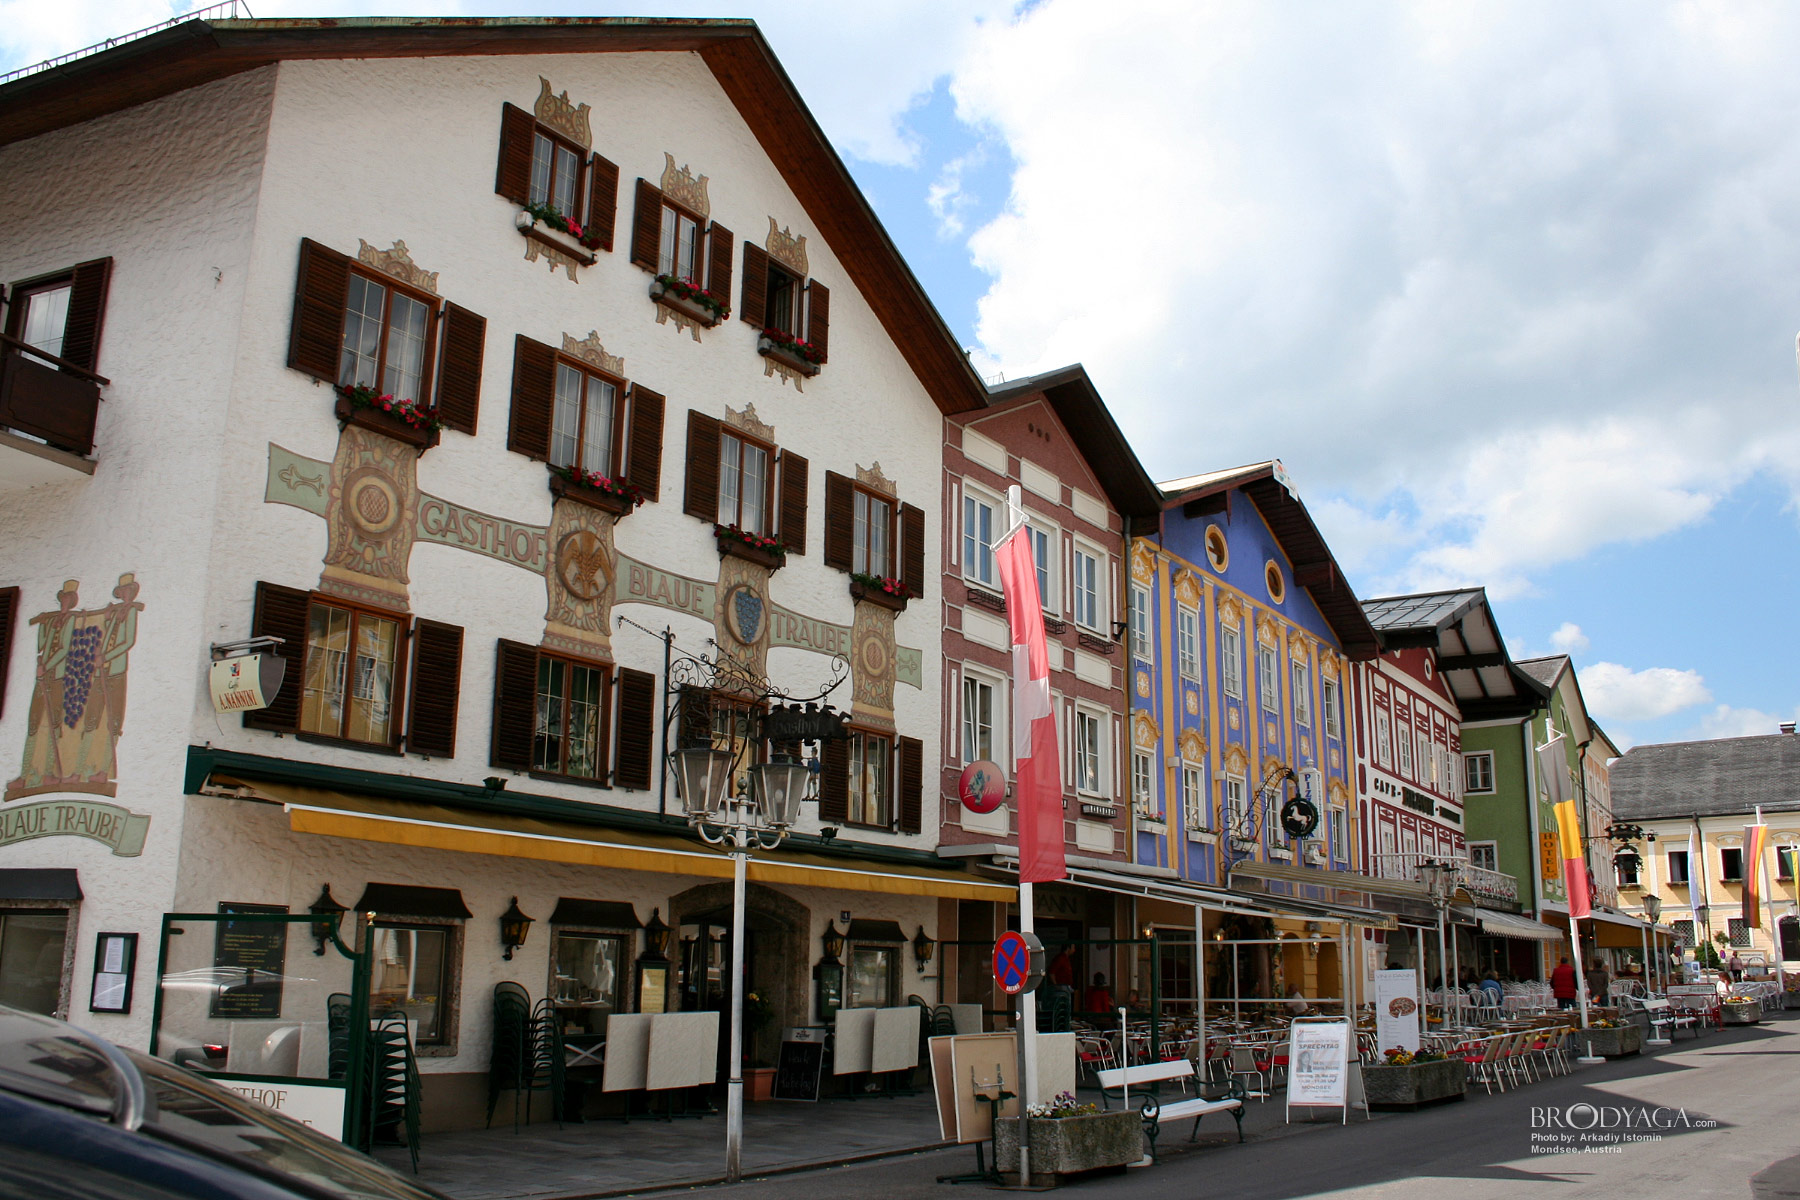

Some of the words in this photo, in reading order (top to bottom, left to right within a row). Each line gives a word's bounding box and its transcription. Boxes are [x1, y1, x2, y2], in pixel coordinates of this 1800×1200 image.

[421, 501, 546, 565] GASTHOF
[629, 564, 705, 614] BLAUE
[771, 610, 849, 653] TRAUBE
[55, 806, 123, 843] TRAUBE
[1543, 833, 1555, 873] HOTEL
